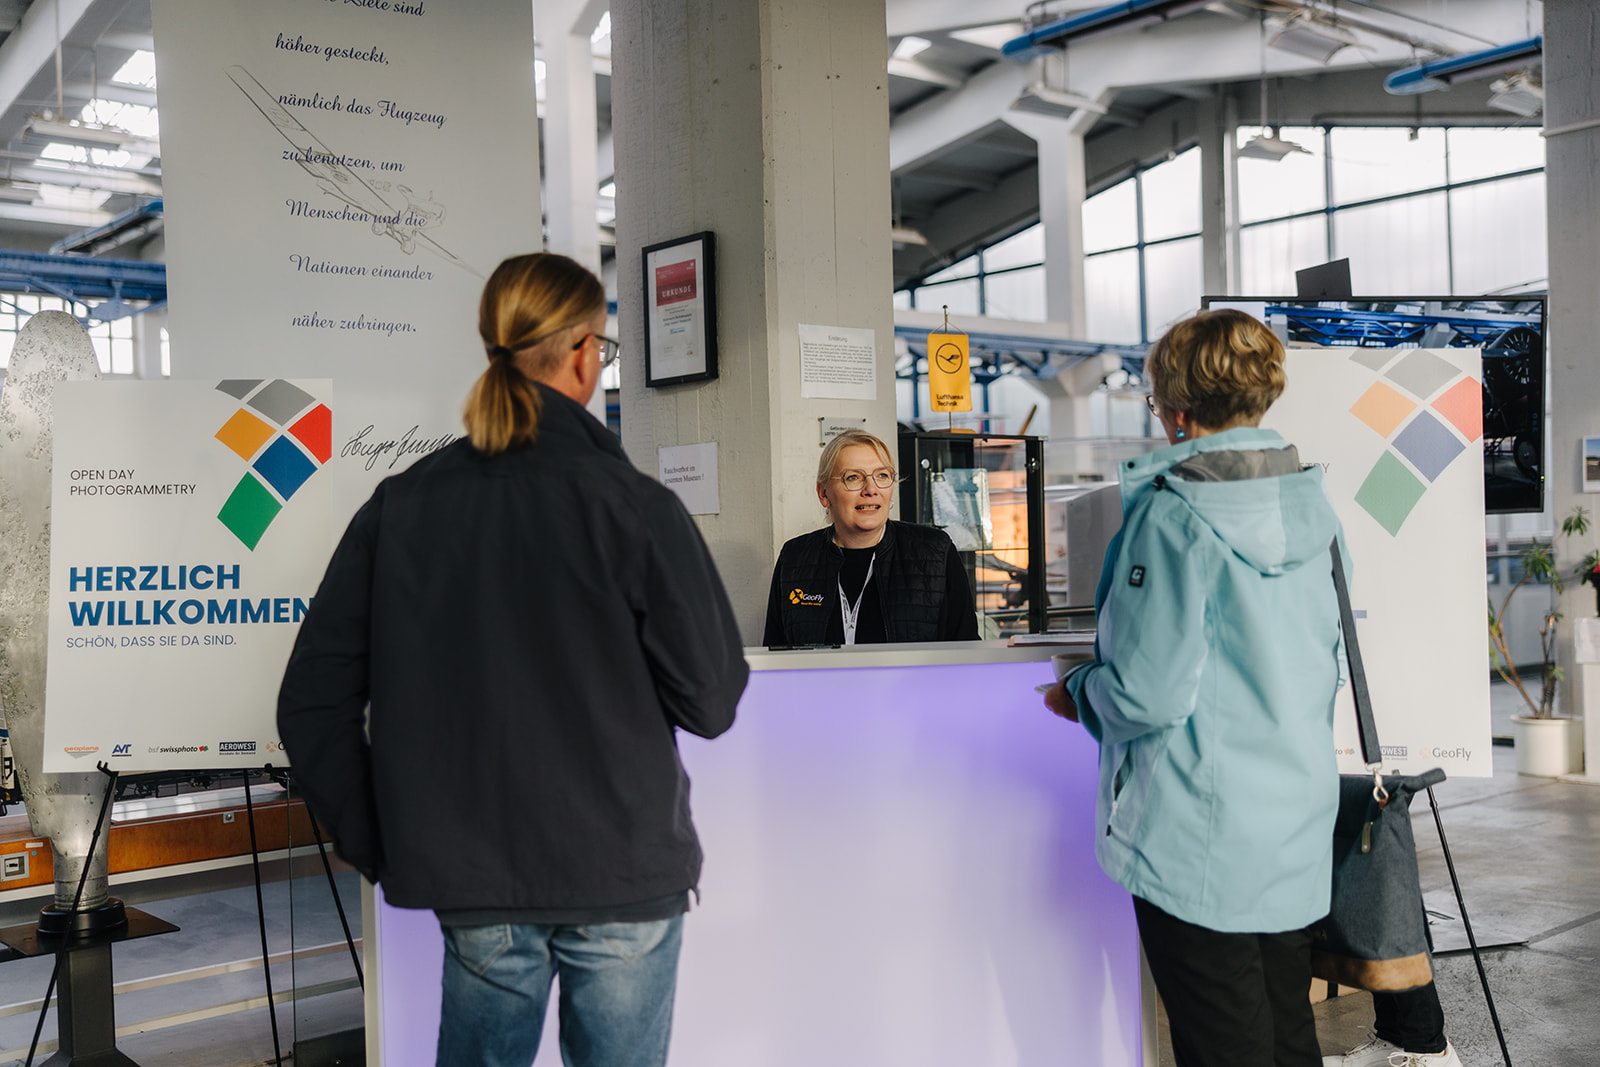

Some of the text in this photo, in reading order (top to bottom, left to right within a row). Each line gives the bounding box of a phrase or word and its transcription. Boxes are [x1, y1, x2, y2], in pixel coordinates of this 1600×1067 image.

[393, 1, 425, 16] sind
[275, 33, 389, 65] höher gesteckt,
[278, 92, 447, 129] nämlich das Flugzeug
[282, 146, 405, 172] zu benutzen, um
[286, 199, 427, 227] Menschen und die
[289, 254, 434, 280] Nationen einander
[661, 285, 692, 298] URKUNDE
[292, 311, 416, 337] näher zubringen.
[70, 469, 135, 480] OPEN DAY
[70, 484, 196, 496] PHOTOGRAMMETRY
[69, 564, 240, 592] HERZLICH
[803, 594, 824, 602] GeoFly
[66, 634, 237, 649] SCHÖN, DASS SIE DA SIND.
[64, 745, 99, 753] geoplane
[159, 745, 198, 754] swissphoto
[219, 742, 256, 751] AEROWEST
[1432, 747, 1472, 760] GeoFly
